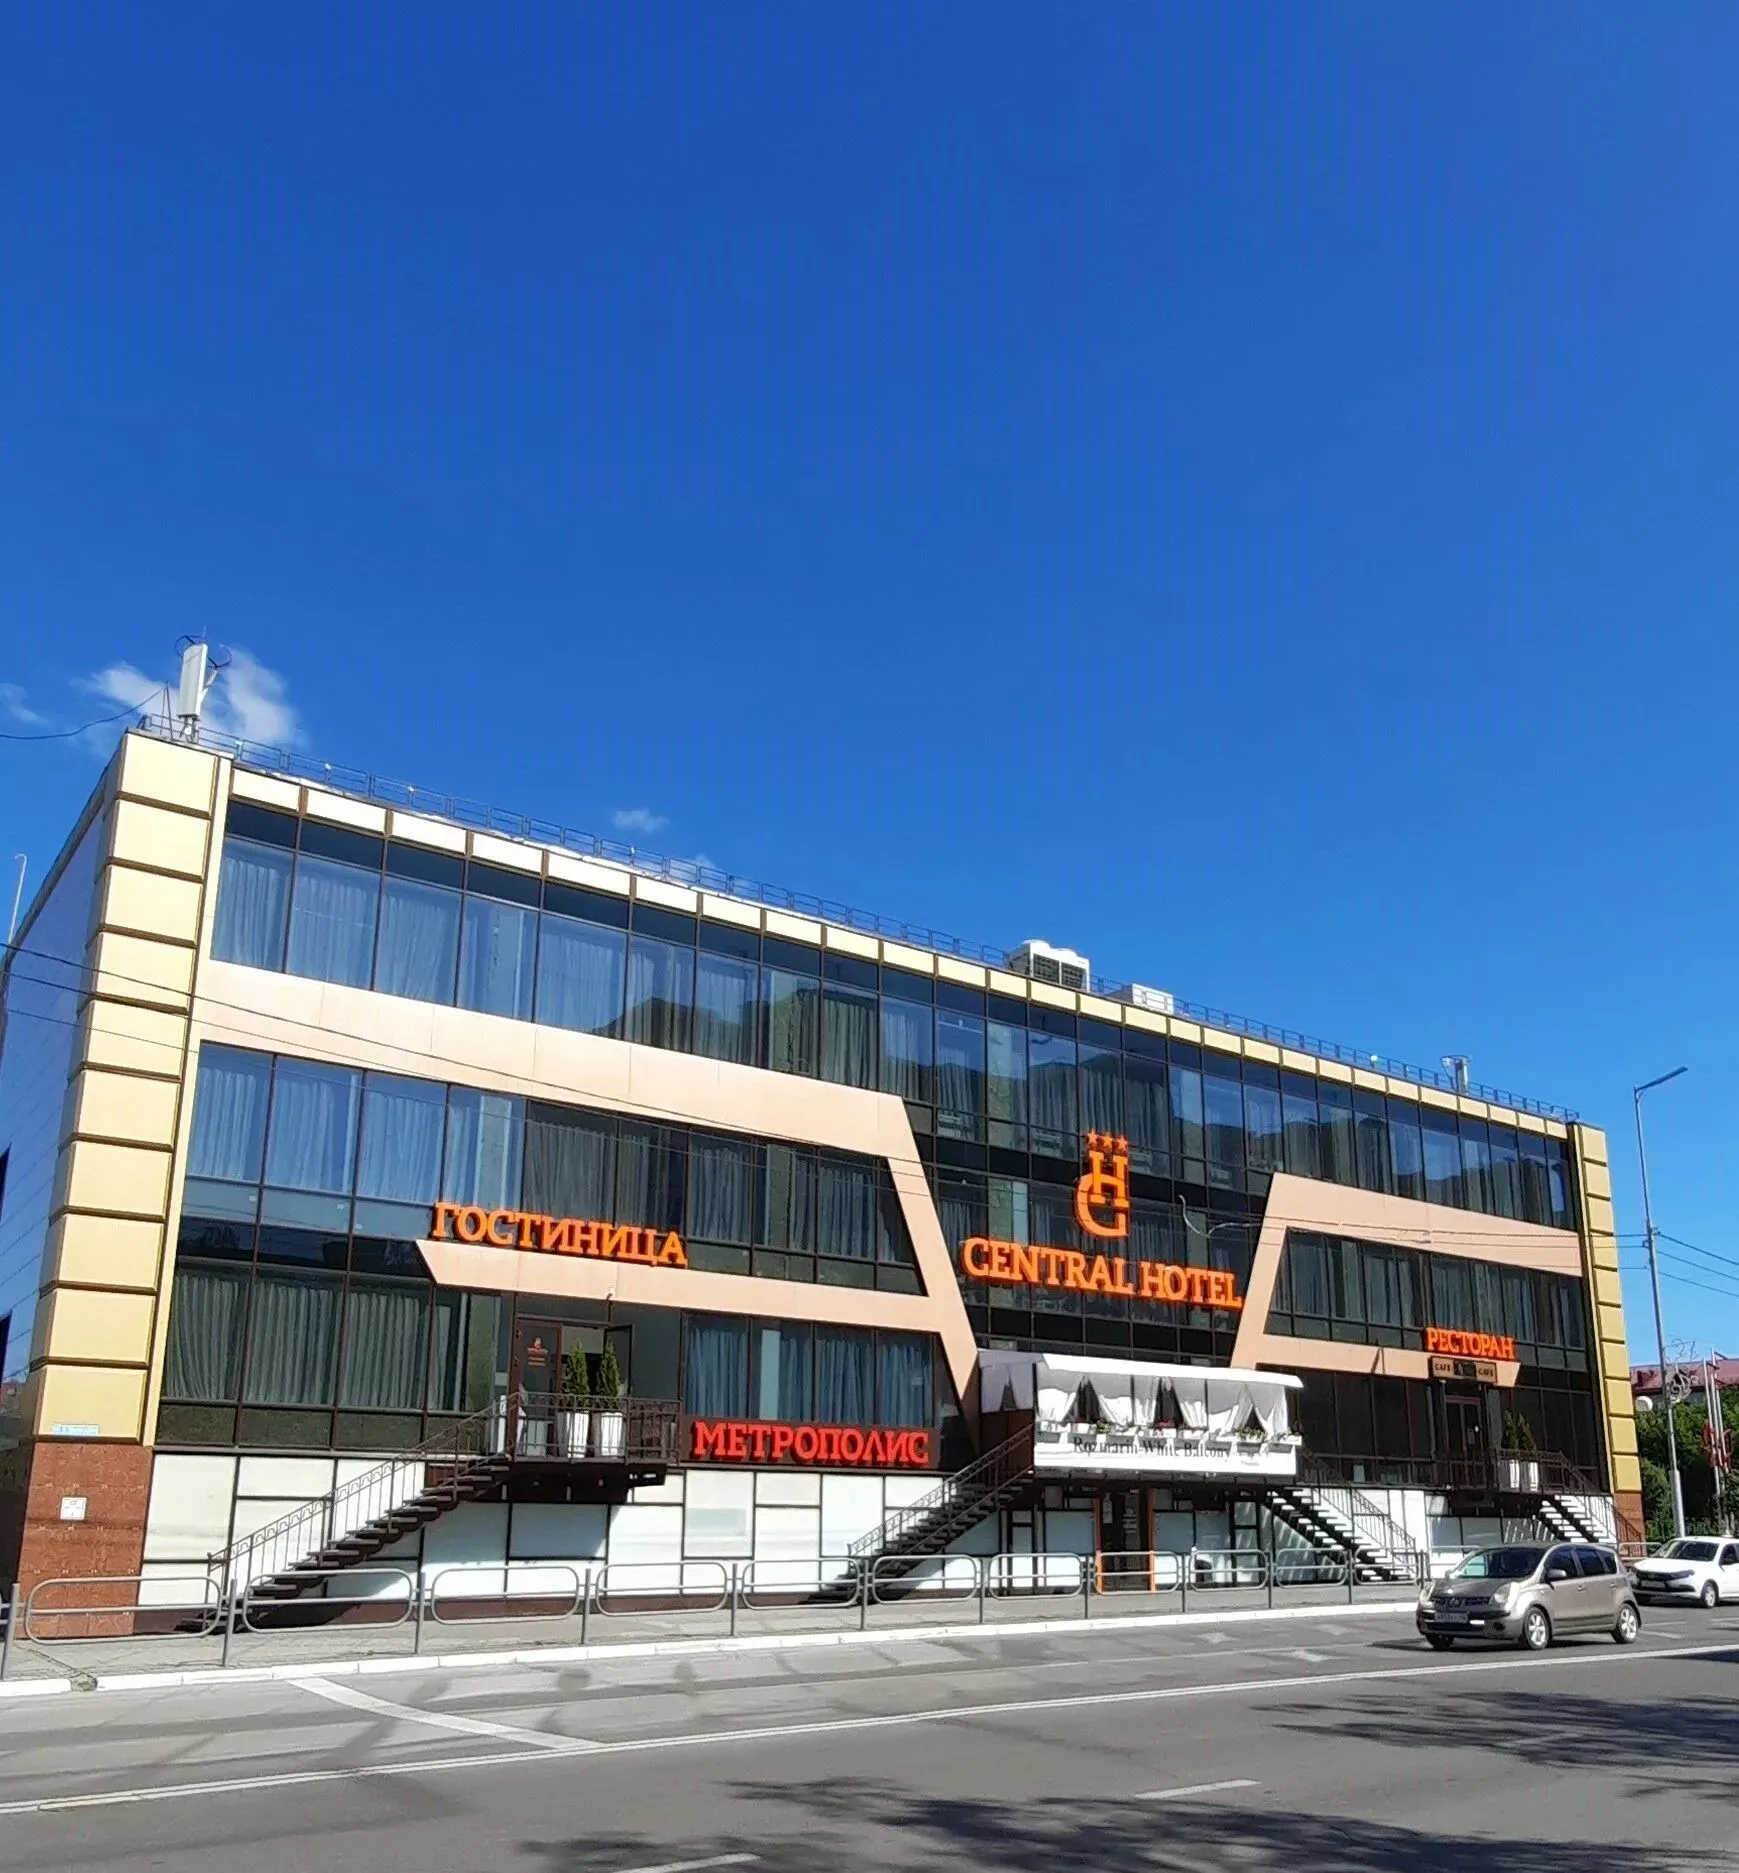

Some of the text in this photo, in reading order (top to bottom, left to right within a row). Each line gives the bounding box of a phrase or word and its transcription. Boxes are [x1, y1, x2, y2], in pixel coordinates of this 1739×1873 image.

[431, 1201, 688, 1268] ГОСТИНИЦА
[961, 1236, 1243, 1310] CENTRAL HOTEL
[1425, 1326, 1516, 1360] РЕСТОРАН
[692, 1419, 930, 1466] МЕТРОПОЛИС
